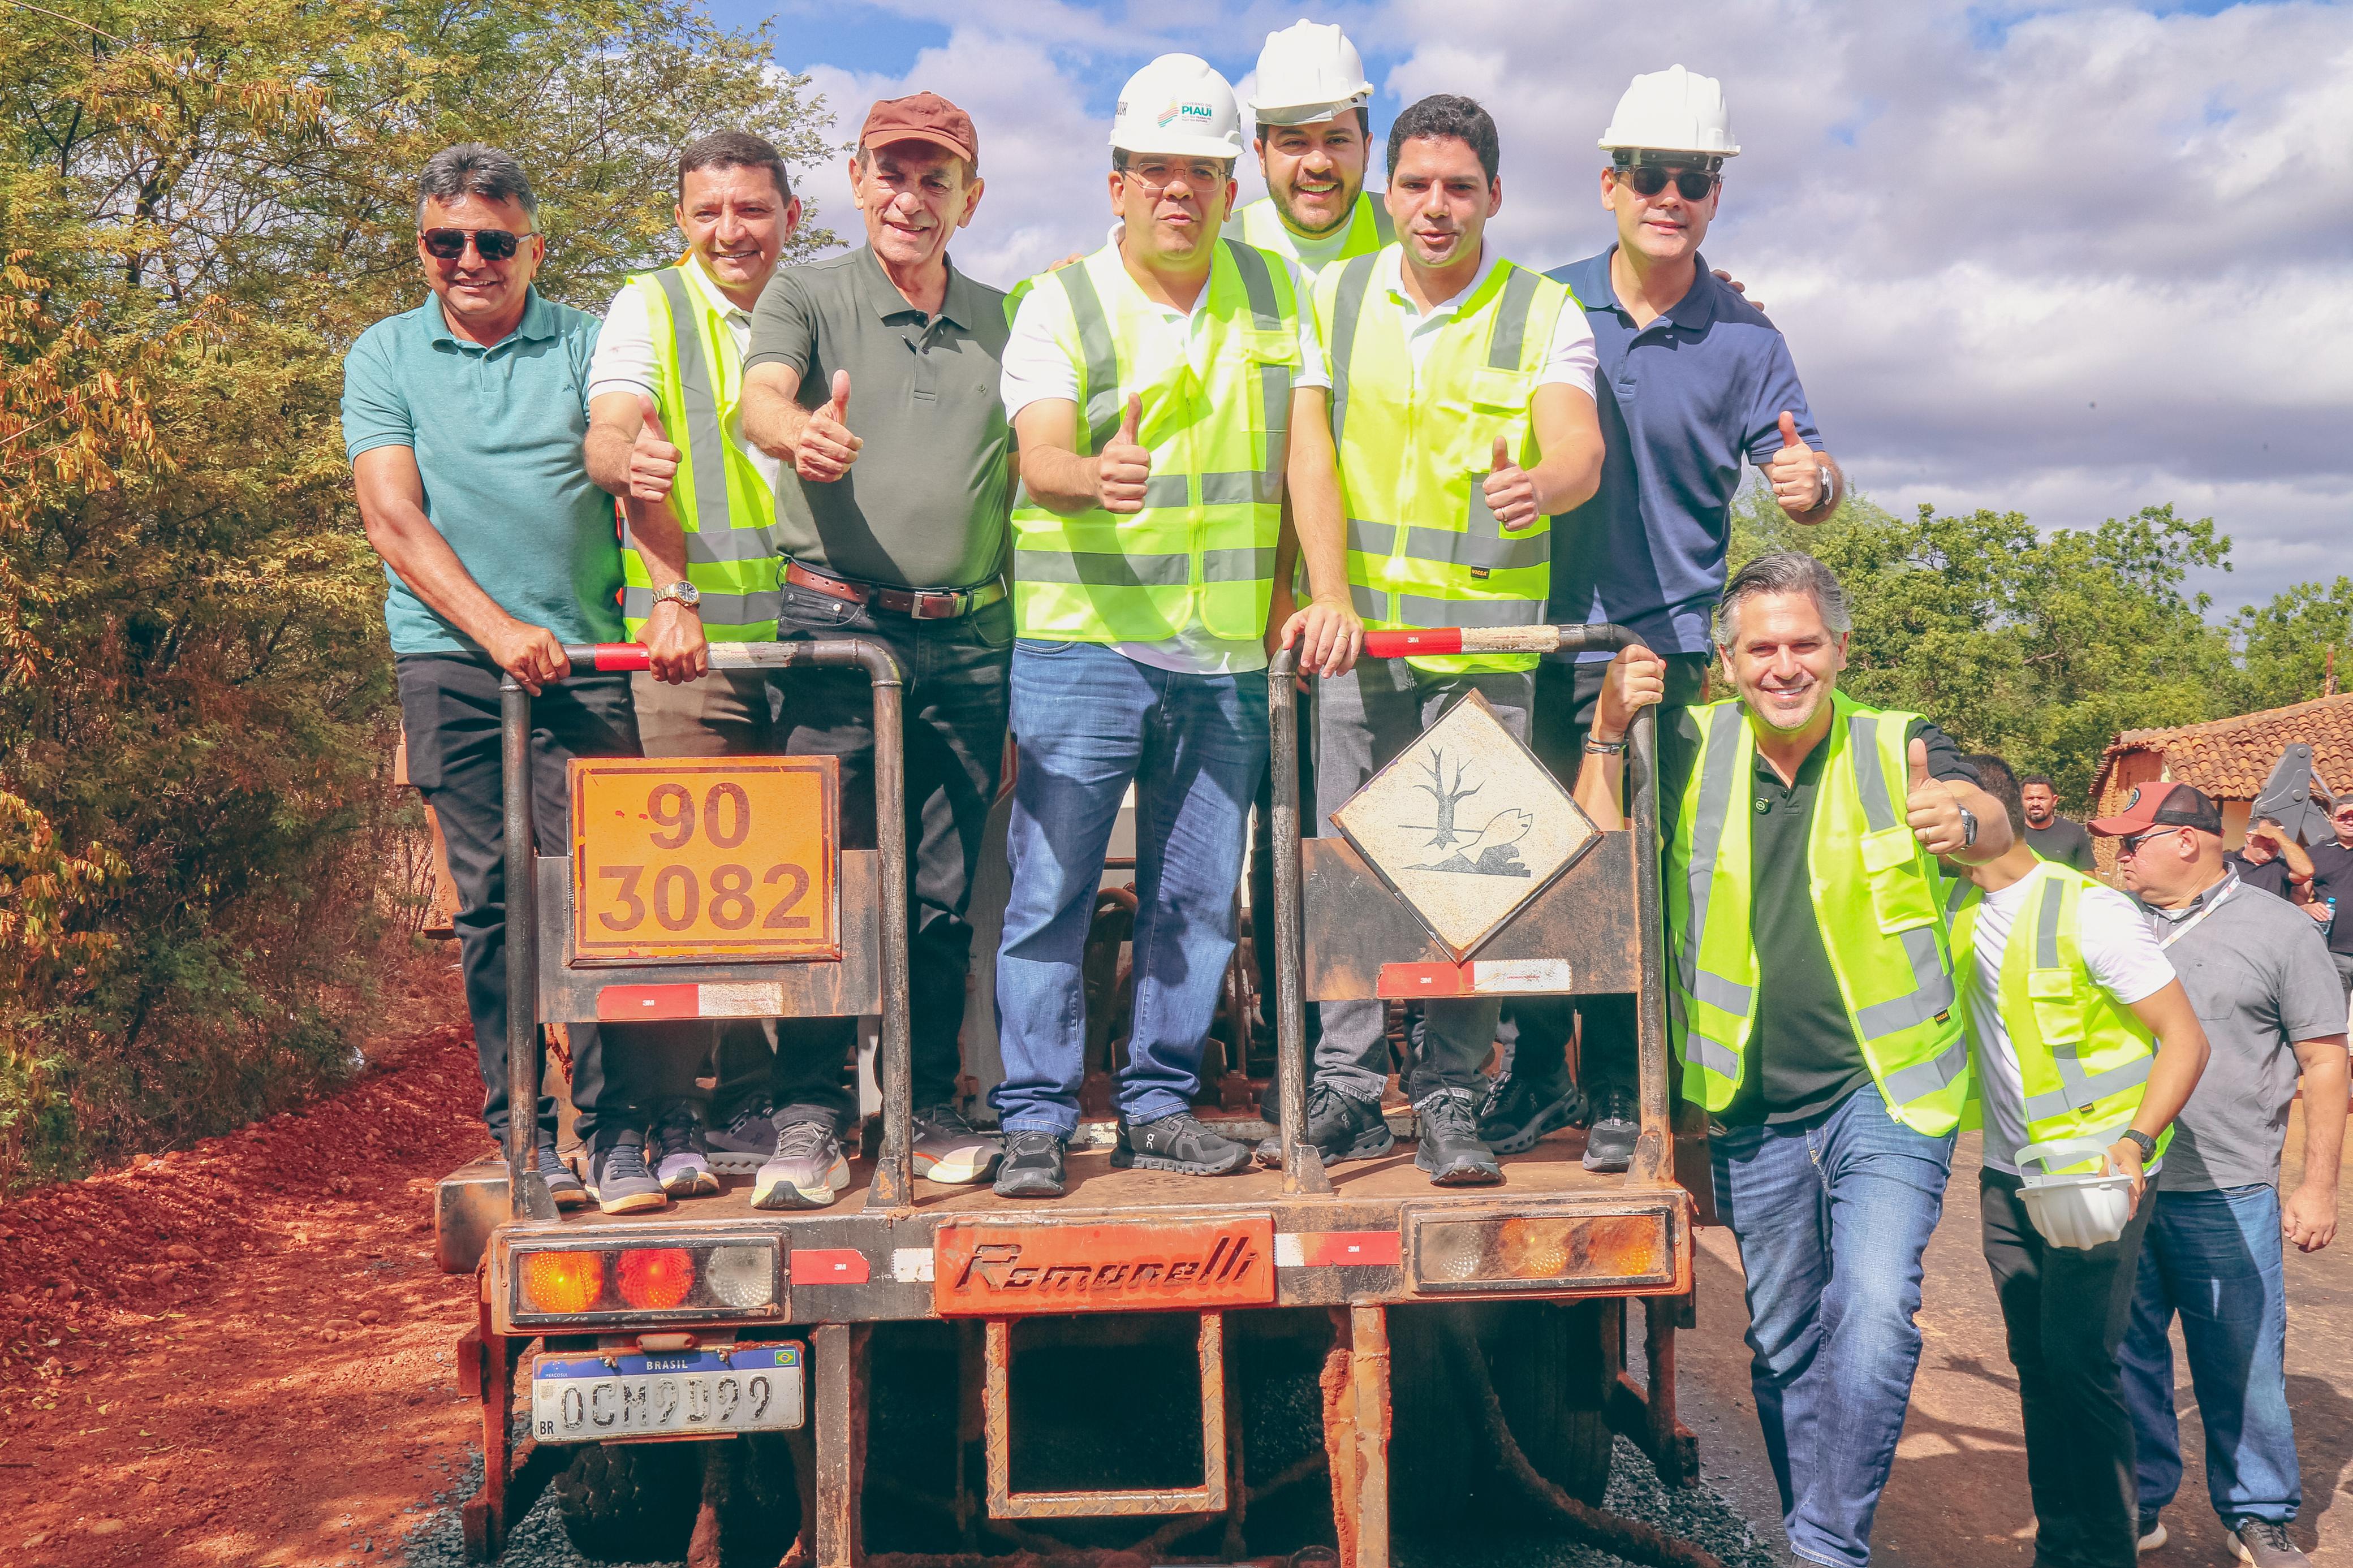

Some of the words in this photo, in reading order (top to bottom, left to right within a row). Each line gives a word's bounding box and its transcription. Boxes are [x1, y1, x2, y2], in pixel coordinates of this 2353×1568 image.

[647, 783, 751, 849] 90
[598, 863, 811, 932] 3082
[953, 1236, 1259, 1293] Romanelli
[646, 1360, 688, 1371] BRASIL
[540, 1420, 554, 1435] BR
